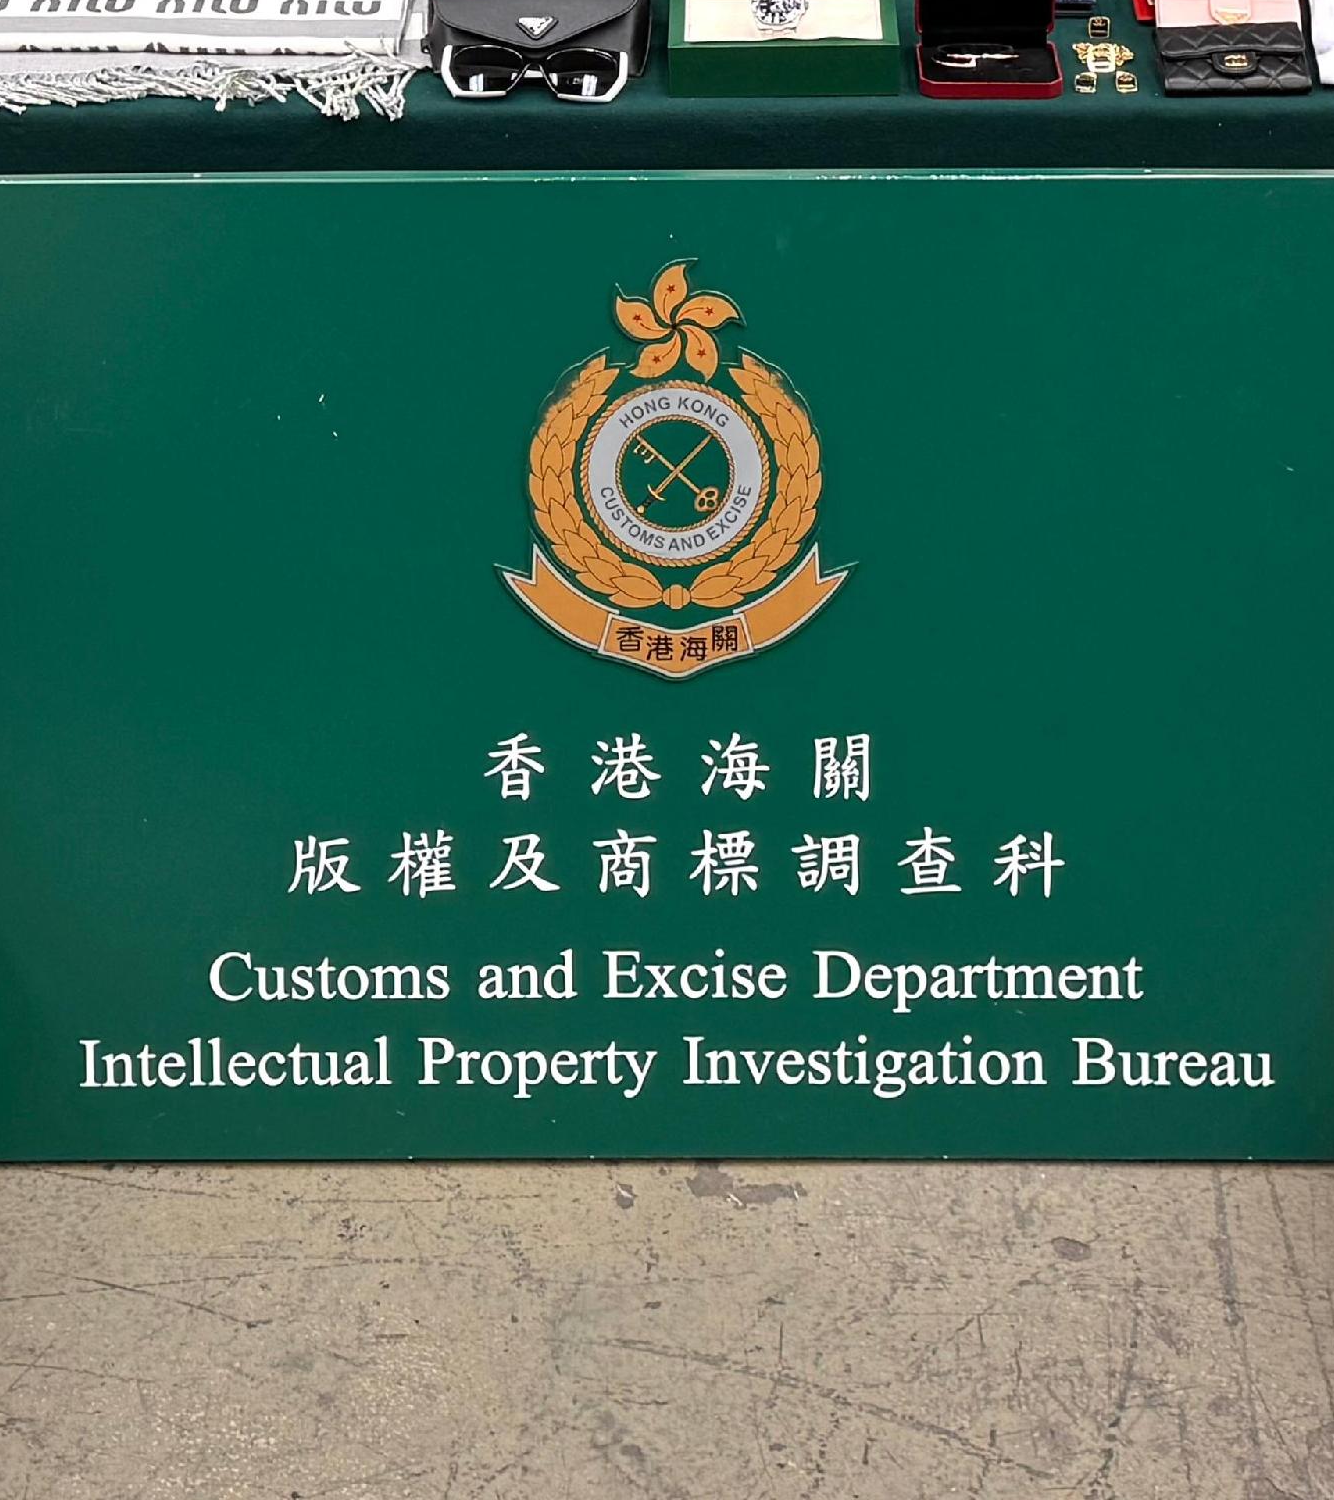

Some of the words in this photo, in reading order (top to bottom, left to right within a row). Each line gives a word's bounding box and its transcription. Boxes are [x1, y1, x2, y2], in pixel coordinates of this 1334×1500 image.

[619, 395, 672, 431] HONG
[677, 395, 730, 431] KONG
[600, 485, 666, 550] CUSTOMS
[667, 532, 707, 553] AND
[707, 484, 753, 543] EXCISE
[615, 625, 739, 663] 香港海關
[483, 732, 870, 802] 香港海關
[287, 826, 1066, 899] 版權及商標調查科
[209, 951, 451, 1002] Customs
[478, 948, 578, 999] and
[602, 948, 787, 999] Excise
[812, 950, 1144, 1013] Department
[79, 1035, 393, 1088] Intellectual
[417, 1037, 658, 1099] Property
[682, 1034, 1048, 1099] Investigation
[1071, 1037, 1276, 1087] Bureau
